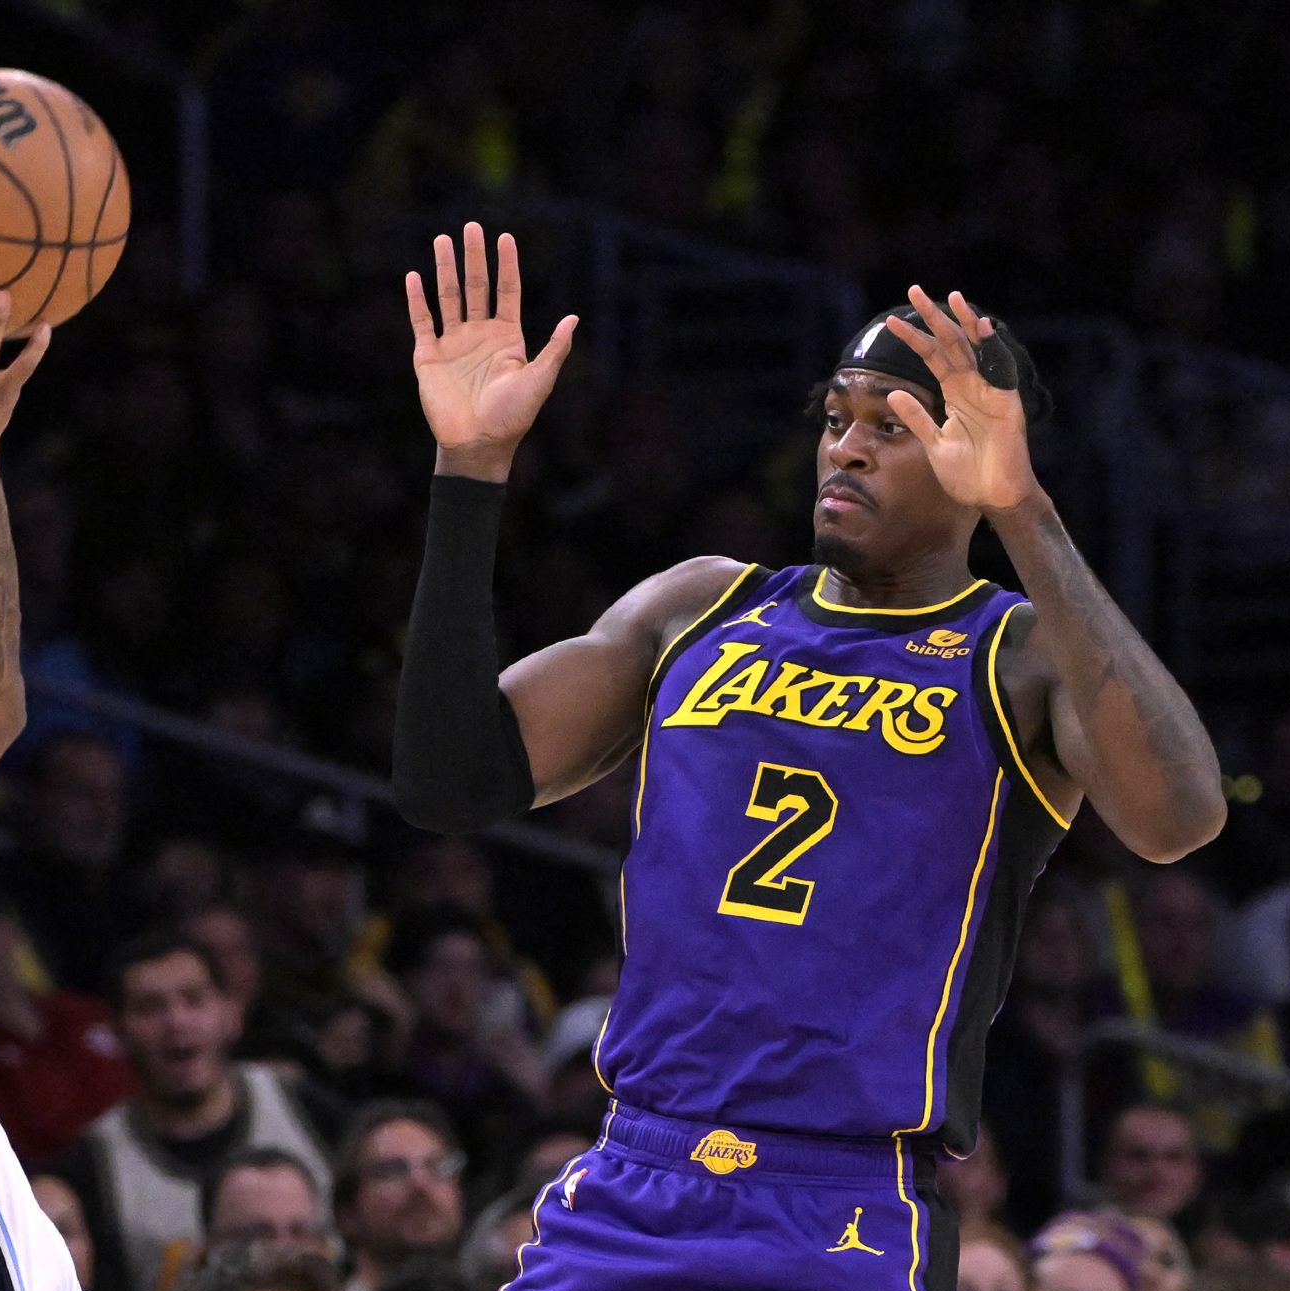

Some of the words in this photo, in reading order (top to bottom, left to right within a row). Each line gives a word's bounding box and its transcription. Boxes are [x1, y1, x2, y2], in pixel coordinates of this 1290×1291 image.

[905, 640, 971, 659] bibigo
[661, 641, 959, 755] LAKERS
[716, 761, 839, 926] 2
[694, 1139, 753, 1166] LAKERS
